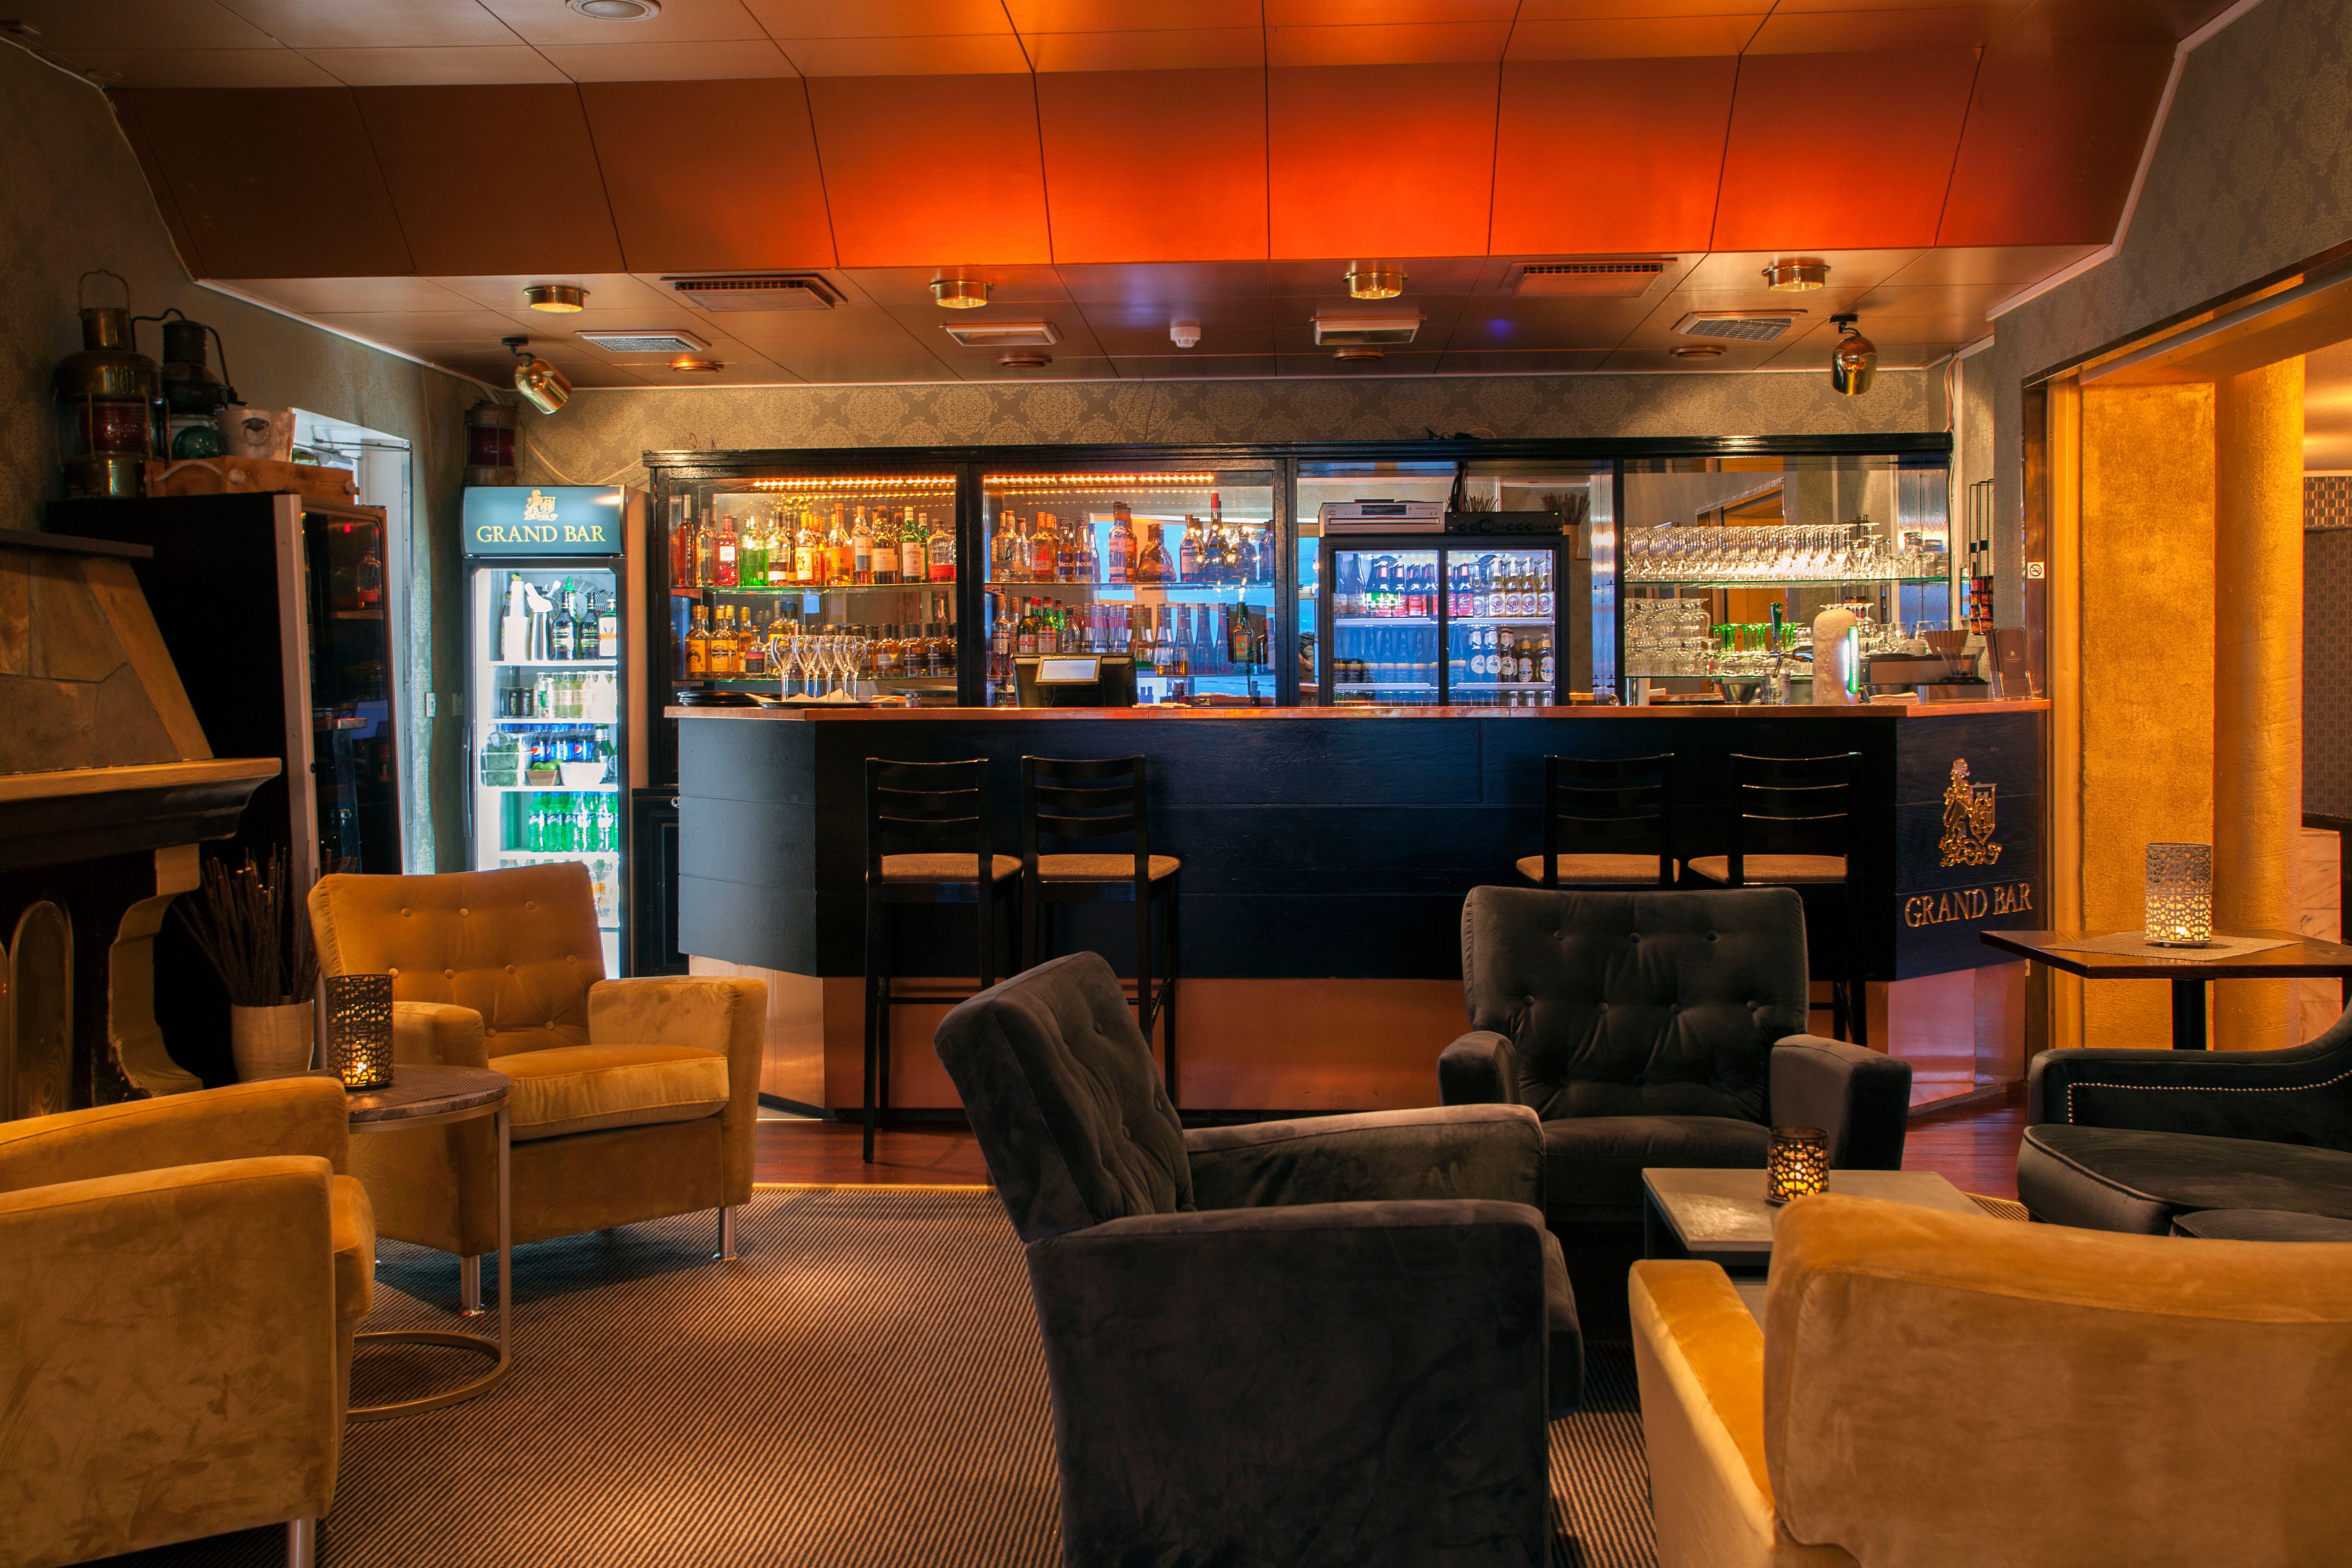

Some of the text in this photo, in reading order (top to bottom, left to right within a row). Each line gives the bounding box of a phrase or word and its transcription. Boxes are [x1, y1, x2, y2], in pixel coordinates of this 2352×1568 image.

[476, 525, 607, 543] GRAND BAR
[1905, 882, 2033, 927] GRAND BAR
